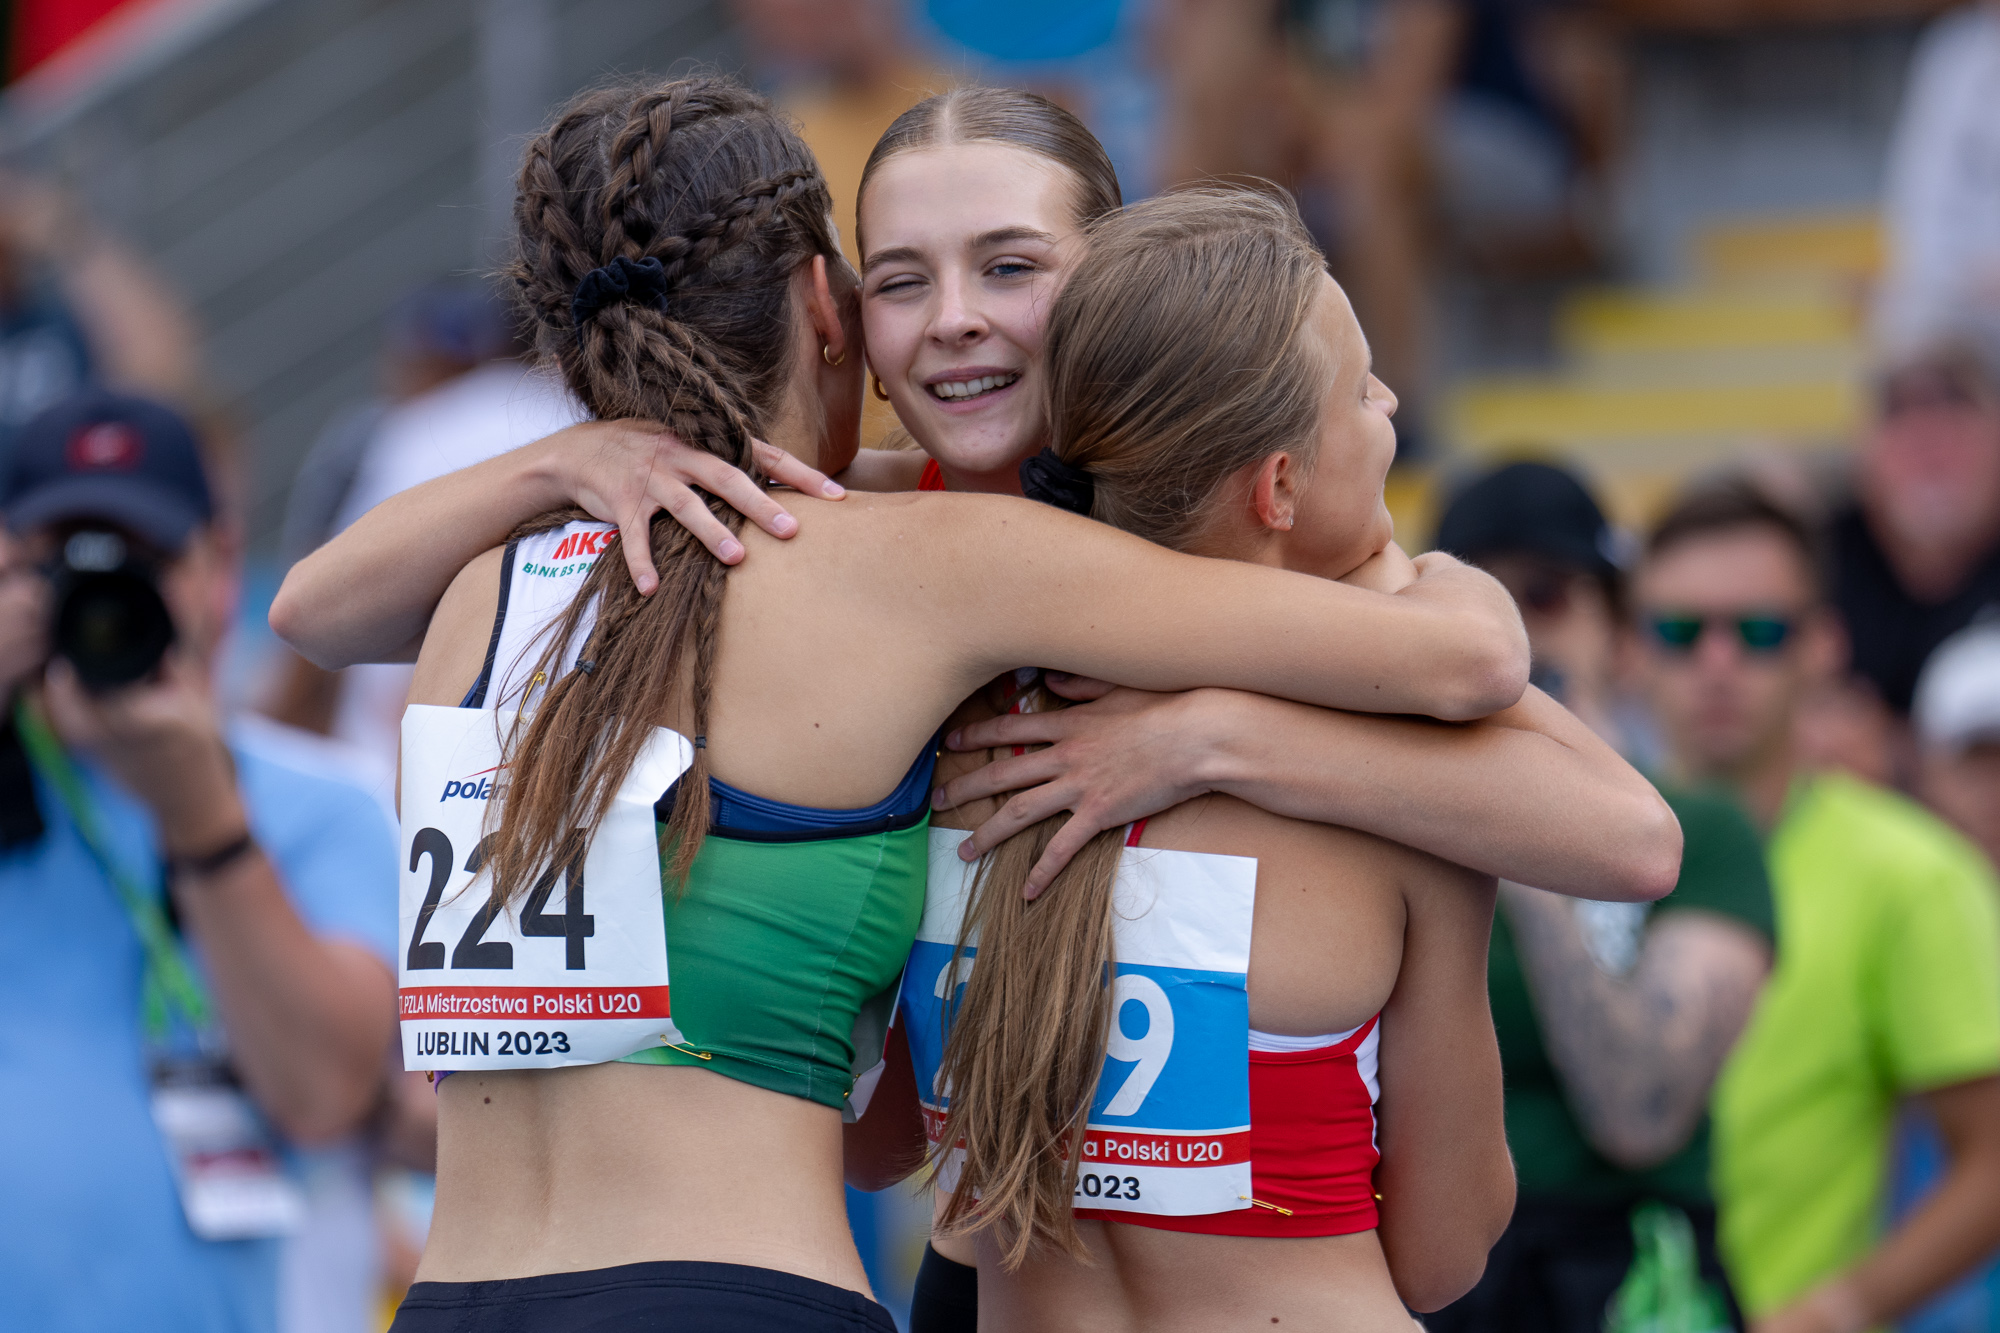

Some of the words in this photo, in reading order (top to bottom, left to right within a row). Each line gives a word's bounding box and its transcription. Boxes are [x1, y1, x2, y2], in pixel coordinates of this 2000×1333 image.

[522, 562, 559, 578] BANK
[560, 563, 575, 577] BS
[406, 827, 595, 971] 224
[404, 994, 424, 1014] PZLA
[426, 992, 527, 1014] Mistrzostwa
[533, 993, 593, 1014] Polski
[599, 993, 641, 1014] U20
[417, 1031, 489, 1056] LUBLIN
[496, 1030, 571, 1056] 2023
[1104, 1139, 1170, 1162] Polski
[1176, 1141, 1223, 1163] U20
